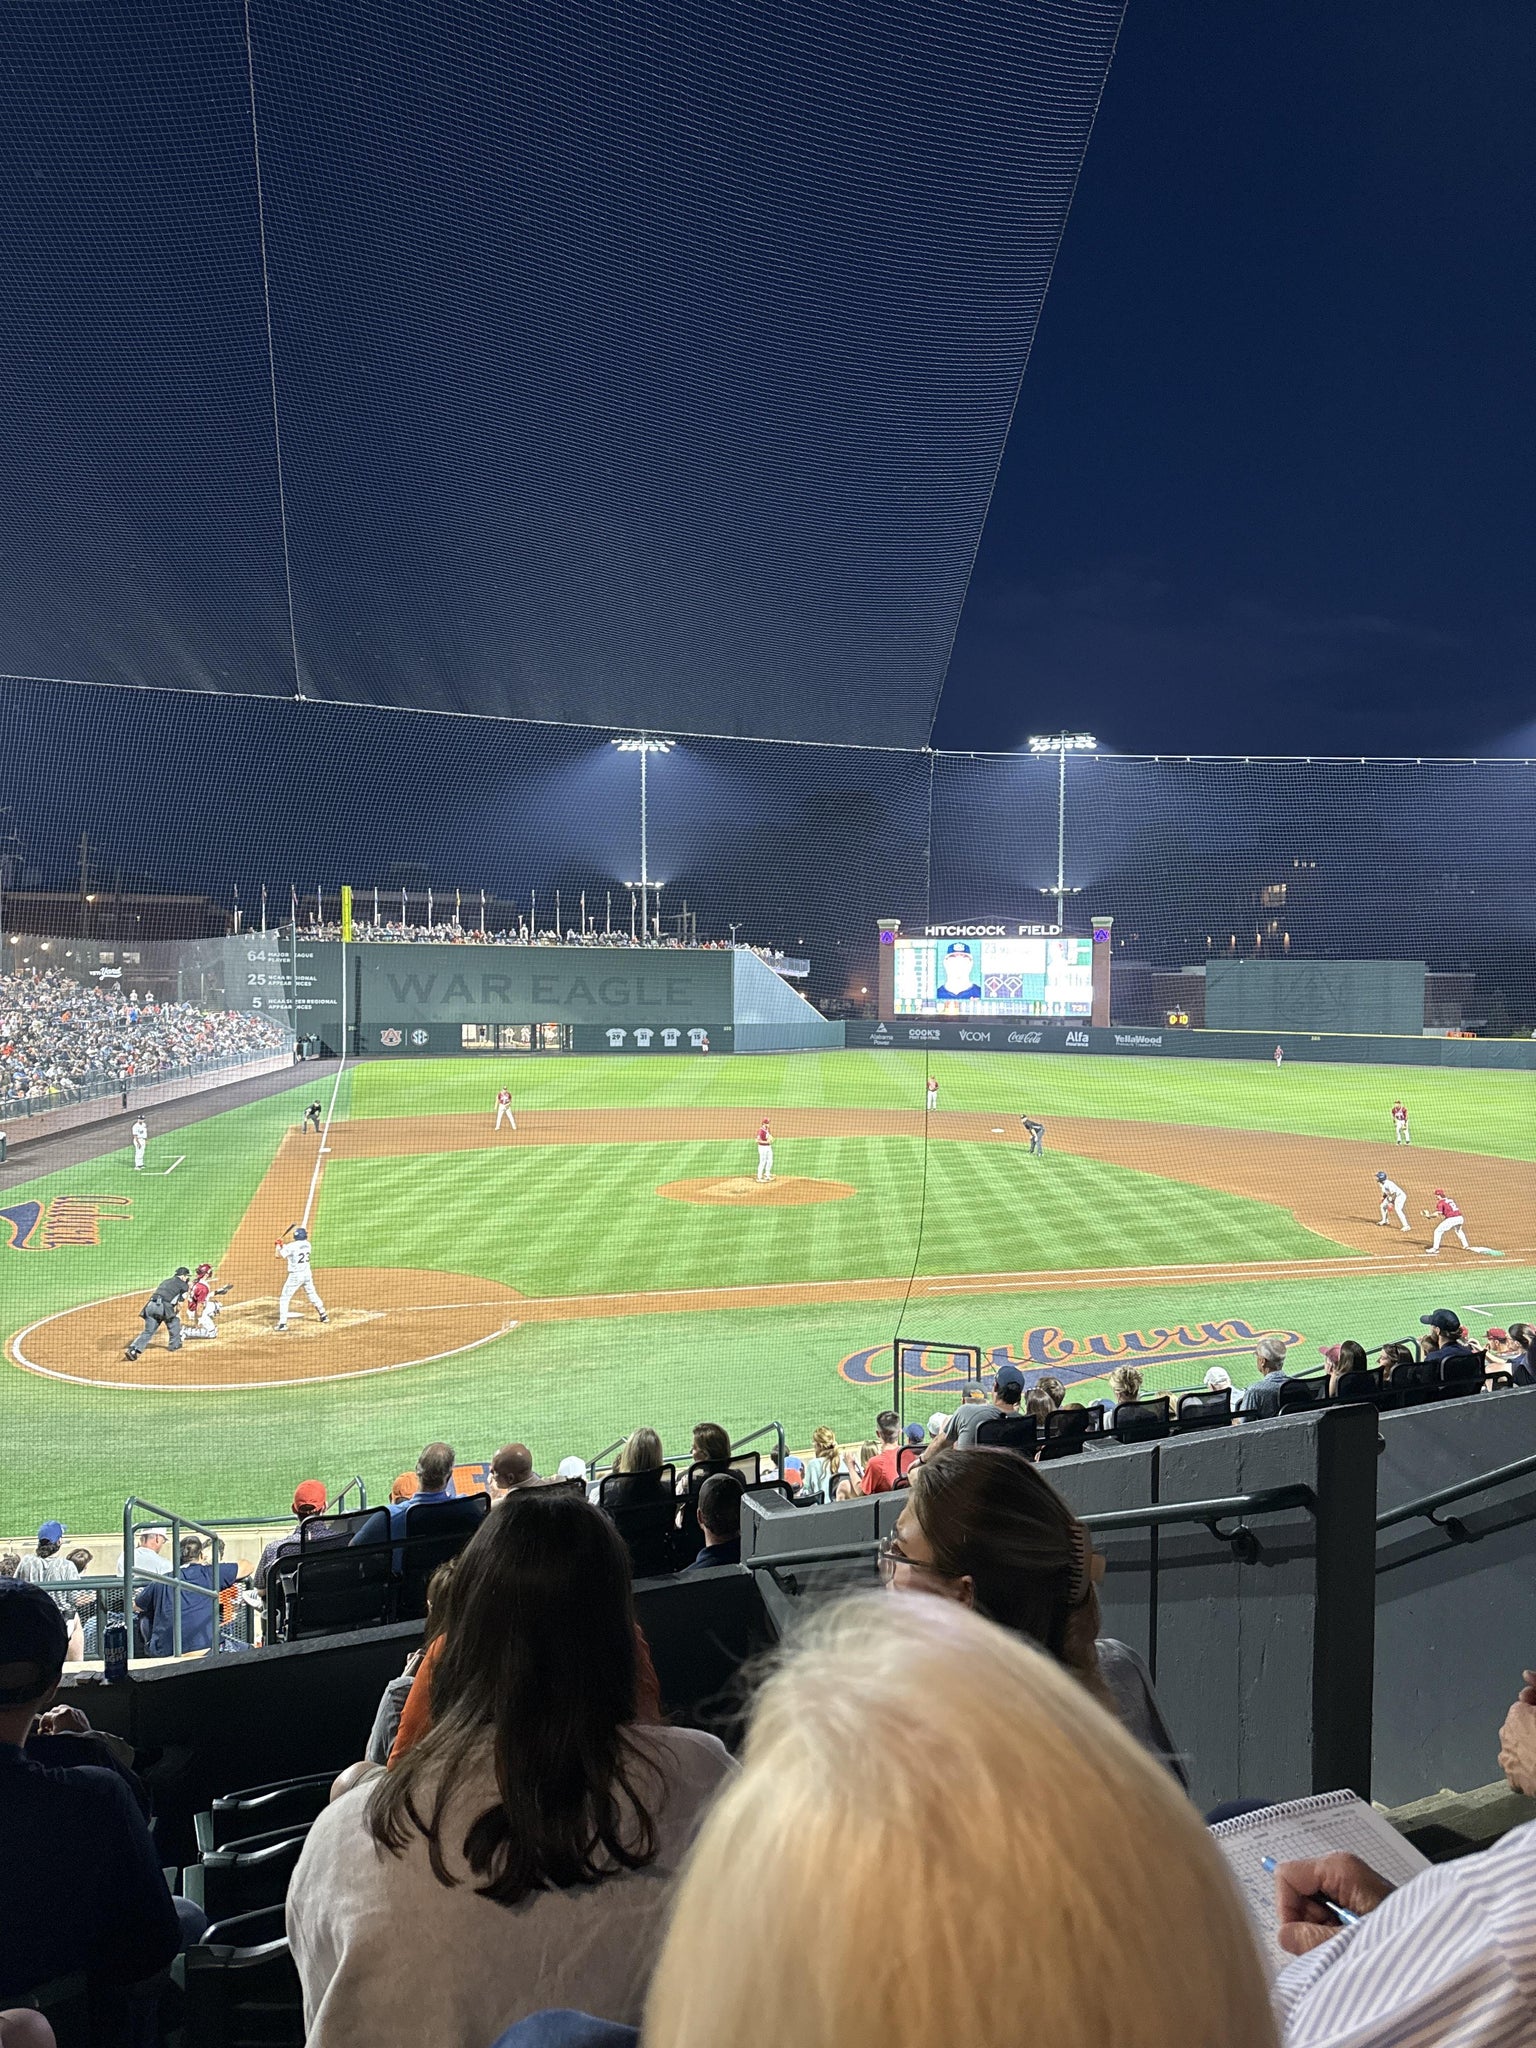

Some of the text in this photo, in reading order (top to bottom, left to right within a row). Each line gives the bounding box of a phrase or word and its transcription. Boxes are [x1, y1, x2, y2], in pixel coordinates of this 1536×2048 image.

[925, 925, 1061, 936] HITCHCOCK FIELD
[247, 950, 266, 961] 64
[247, 974, 266, 986] 25
[387, 973, 693, 1006] WAR EAGLE
[252, 997, 262, 1008] 5
[412, 1029, 429, 1045] SEC
[959, 1029, 991, 1042] VCOM
[1066, 1031, 1089, 1043] Alfa
[1114, 1034, 1162, 1044] YellaWood
[837, 1319, 1305, 1392] Auburn
[105, 1651, 127, 1663] IGHT
